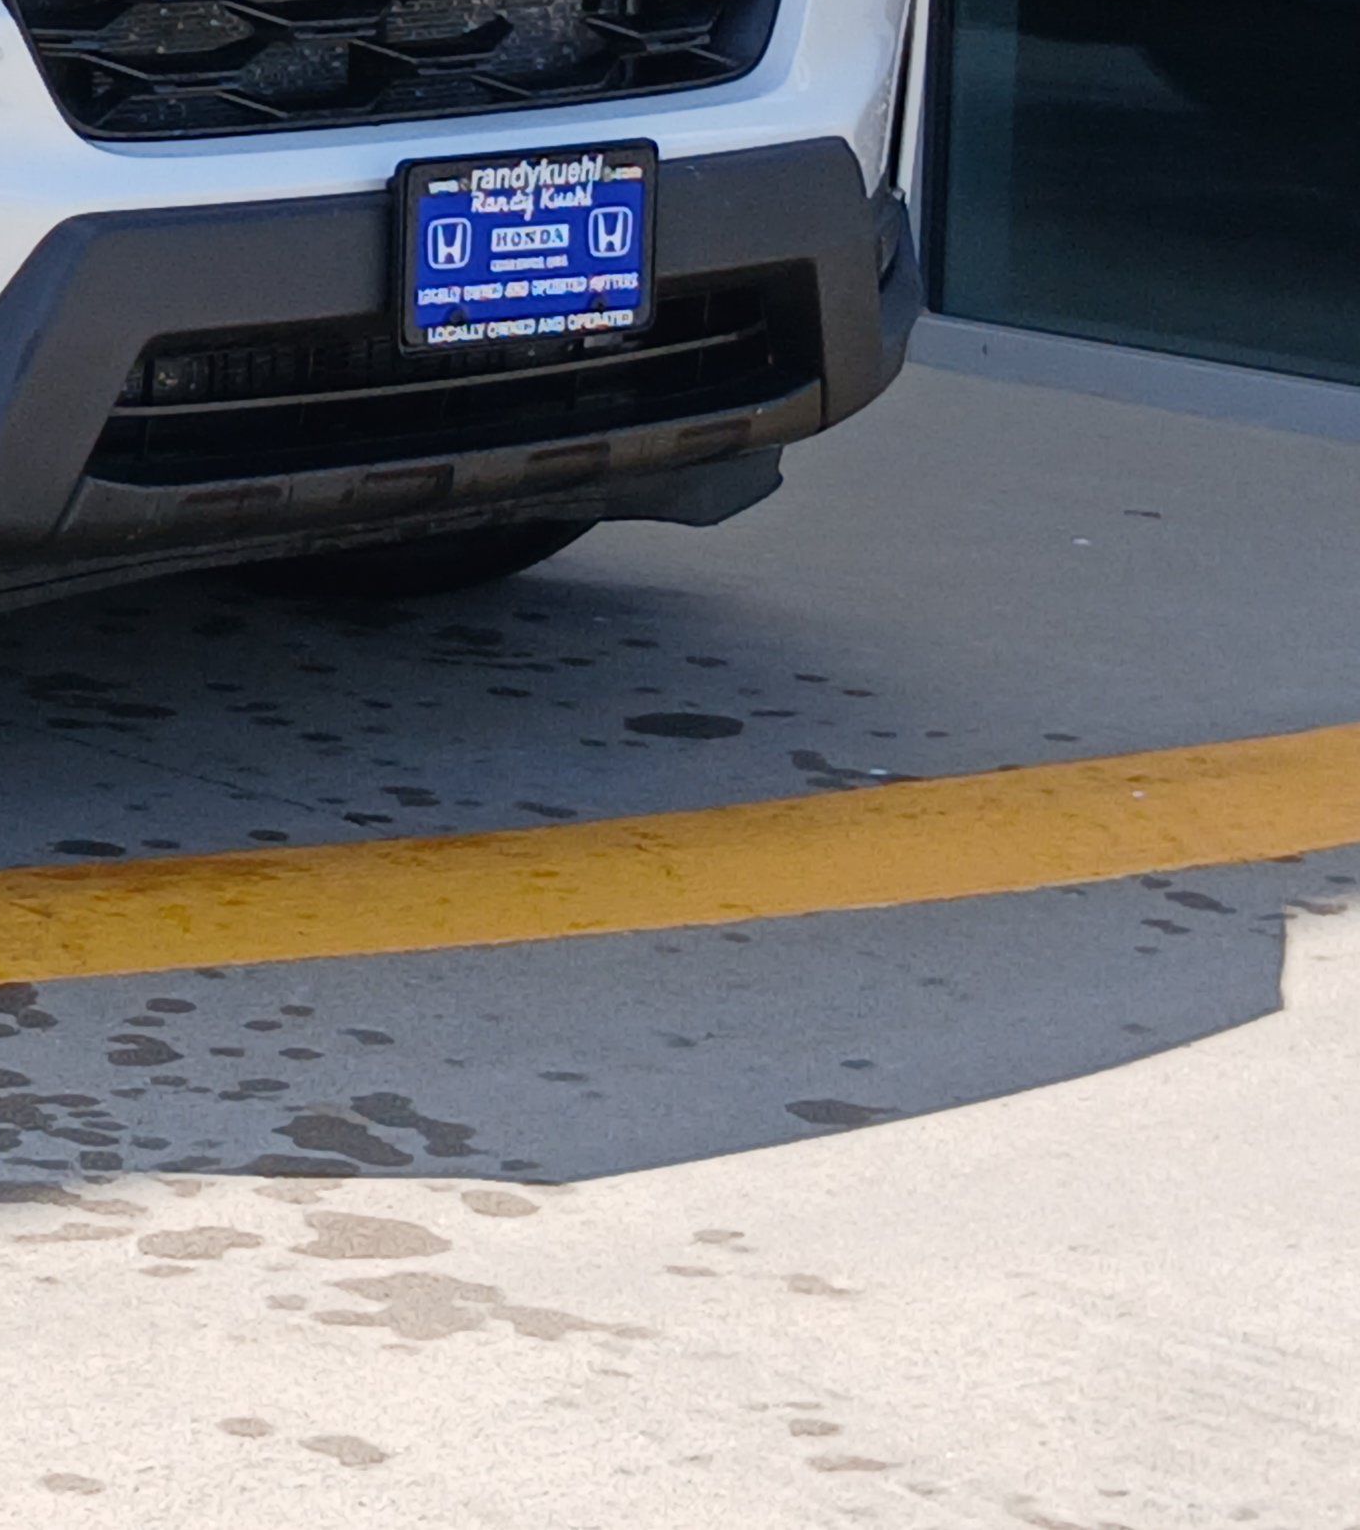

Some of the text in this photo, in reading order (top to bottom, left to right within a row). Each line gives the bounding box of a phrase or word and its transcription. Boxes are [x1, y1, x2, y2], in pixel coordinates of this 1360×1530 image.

[471, 154, 604, 190] randykuehl
[471, 189, 535, 221] Randy
[495, 227, 565, 248] HONDA
